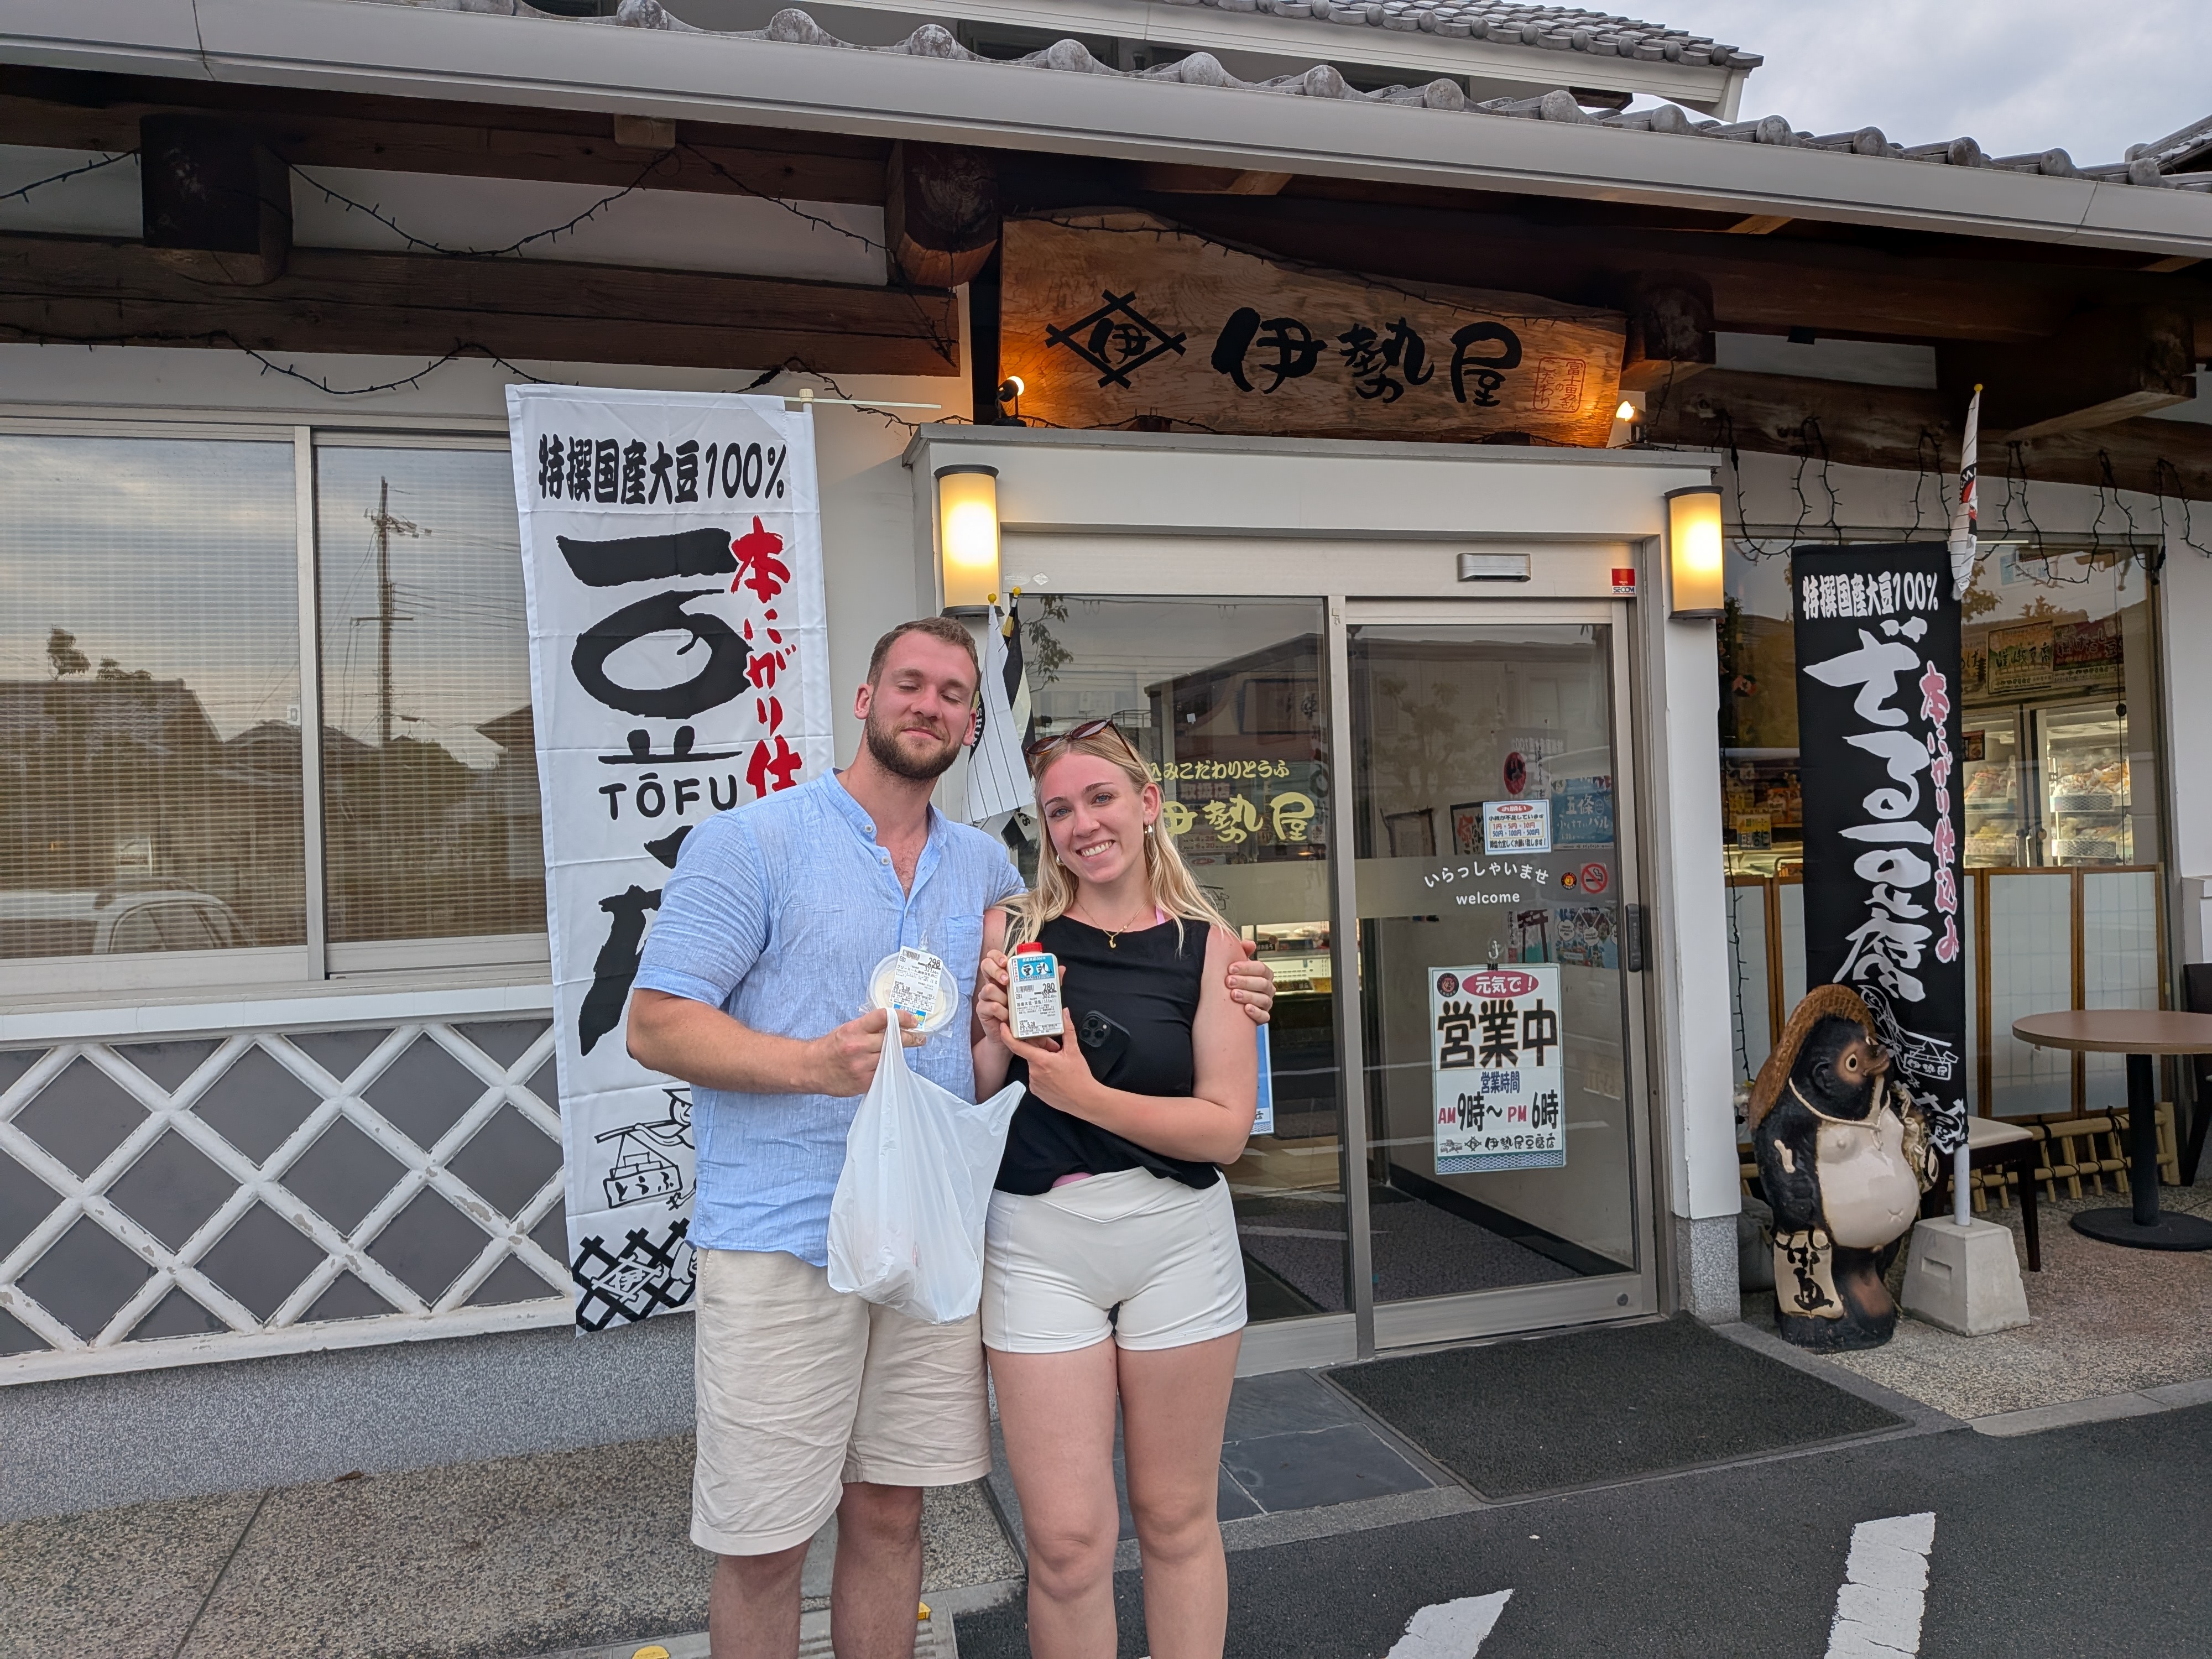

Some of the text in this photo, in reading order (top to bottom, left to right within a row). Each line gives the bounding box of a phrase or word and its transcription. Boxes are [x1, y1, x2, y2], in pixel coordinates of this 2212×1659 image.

[1211, 306, 1523, 408] 伊勢屋
[538, 433, 786, 505] 特撰国産大豆100%
[1802, 571, 1938, 620] 特撰国産大豆100%
[598, 772, 737, 820] TŌFU
[1424, 861, 1549, 888] いらっしゃいませ
[1455, 891, 1520, 905] welcome
[1022, 963, 1052, 976] 豆乳
[1437, 999, 1558, 1069] 営業中
[1480, 1071, 1520, 1094] 営業時間
[1485, 1133, 1556, 1150] 伊勢屋豆腐店
[614, 1171, 674, 1202] とうふ
